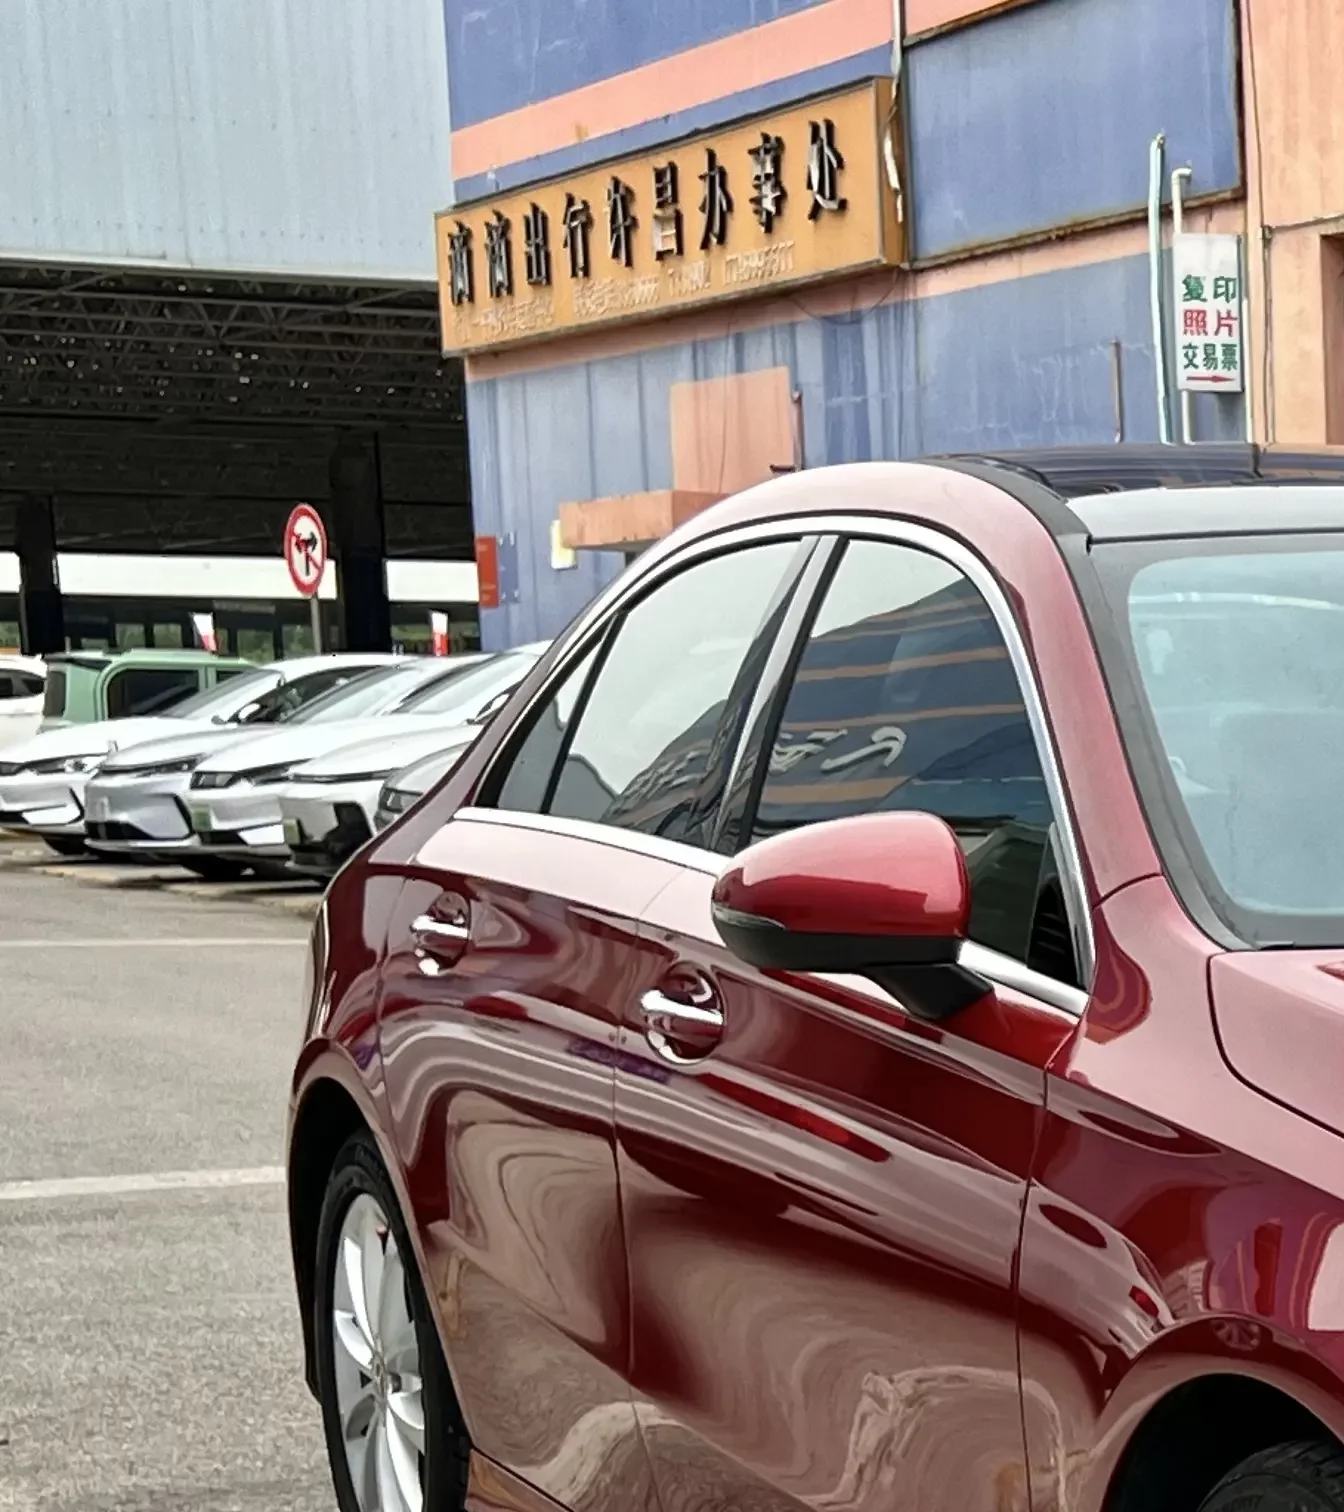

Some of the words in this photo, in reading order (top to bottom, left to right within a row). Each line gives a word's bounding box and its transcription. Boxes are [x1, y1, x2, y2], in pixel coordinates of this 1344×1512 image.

[1182, 274, 1238, 303] 复印
[1182, 308, 1239, 338] 照片
[1182, 342, 1239, 372] 交易票
